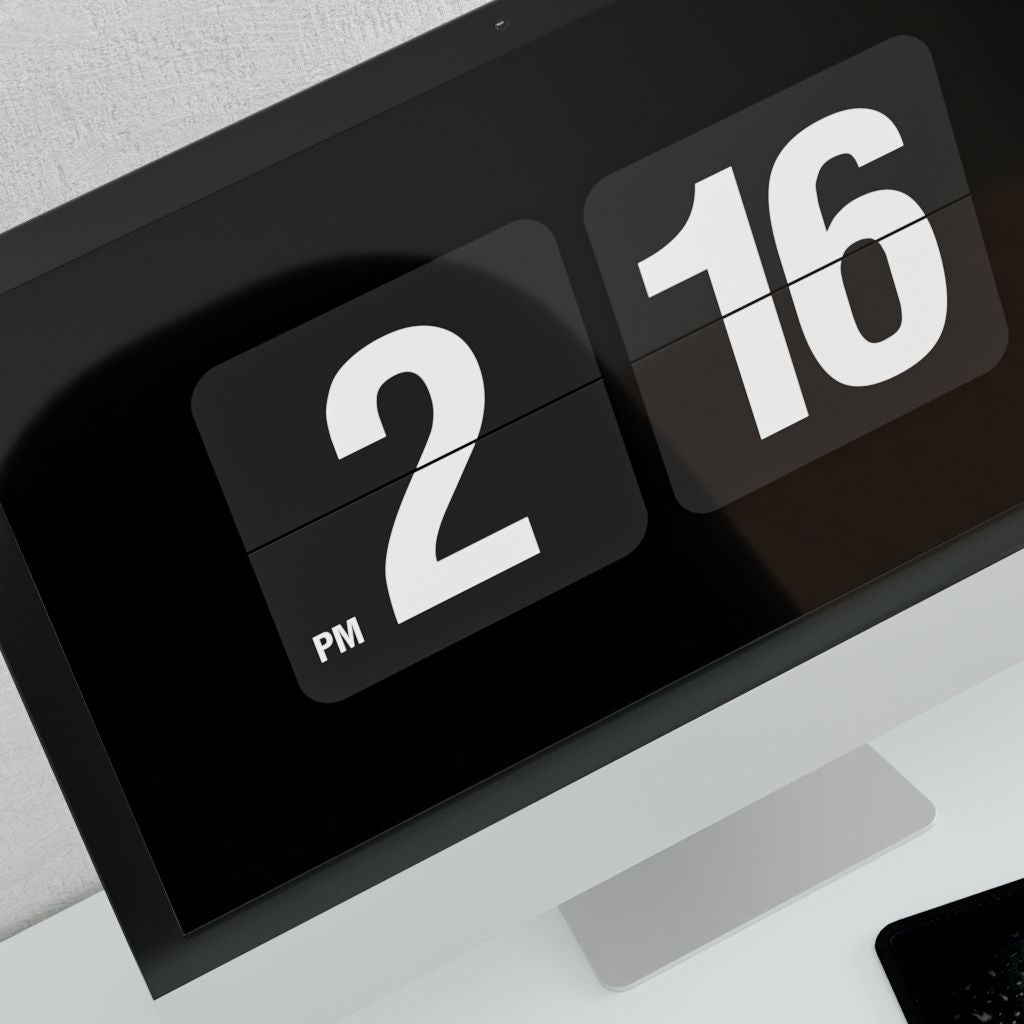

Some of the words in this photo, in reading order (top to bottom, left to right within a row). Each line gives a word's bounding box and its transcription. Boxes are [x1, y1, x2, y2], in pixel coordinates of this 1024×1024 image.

[326, 325, 540, 624] 2
[638, 108, 947, 439] 16
[312, 617, 364, 663] PM
